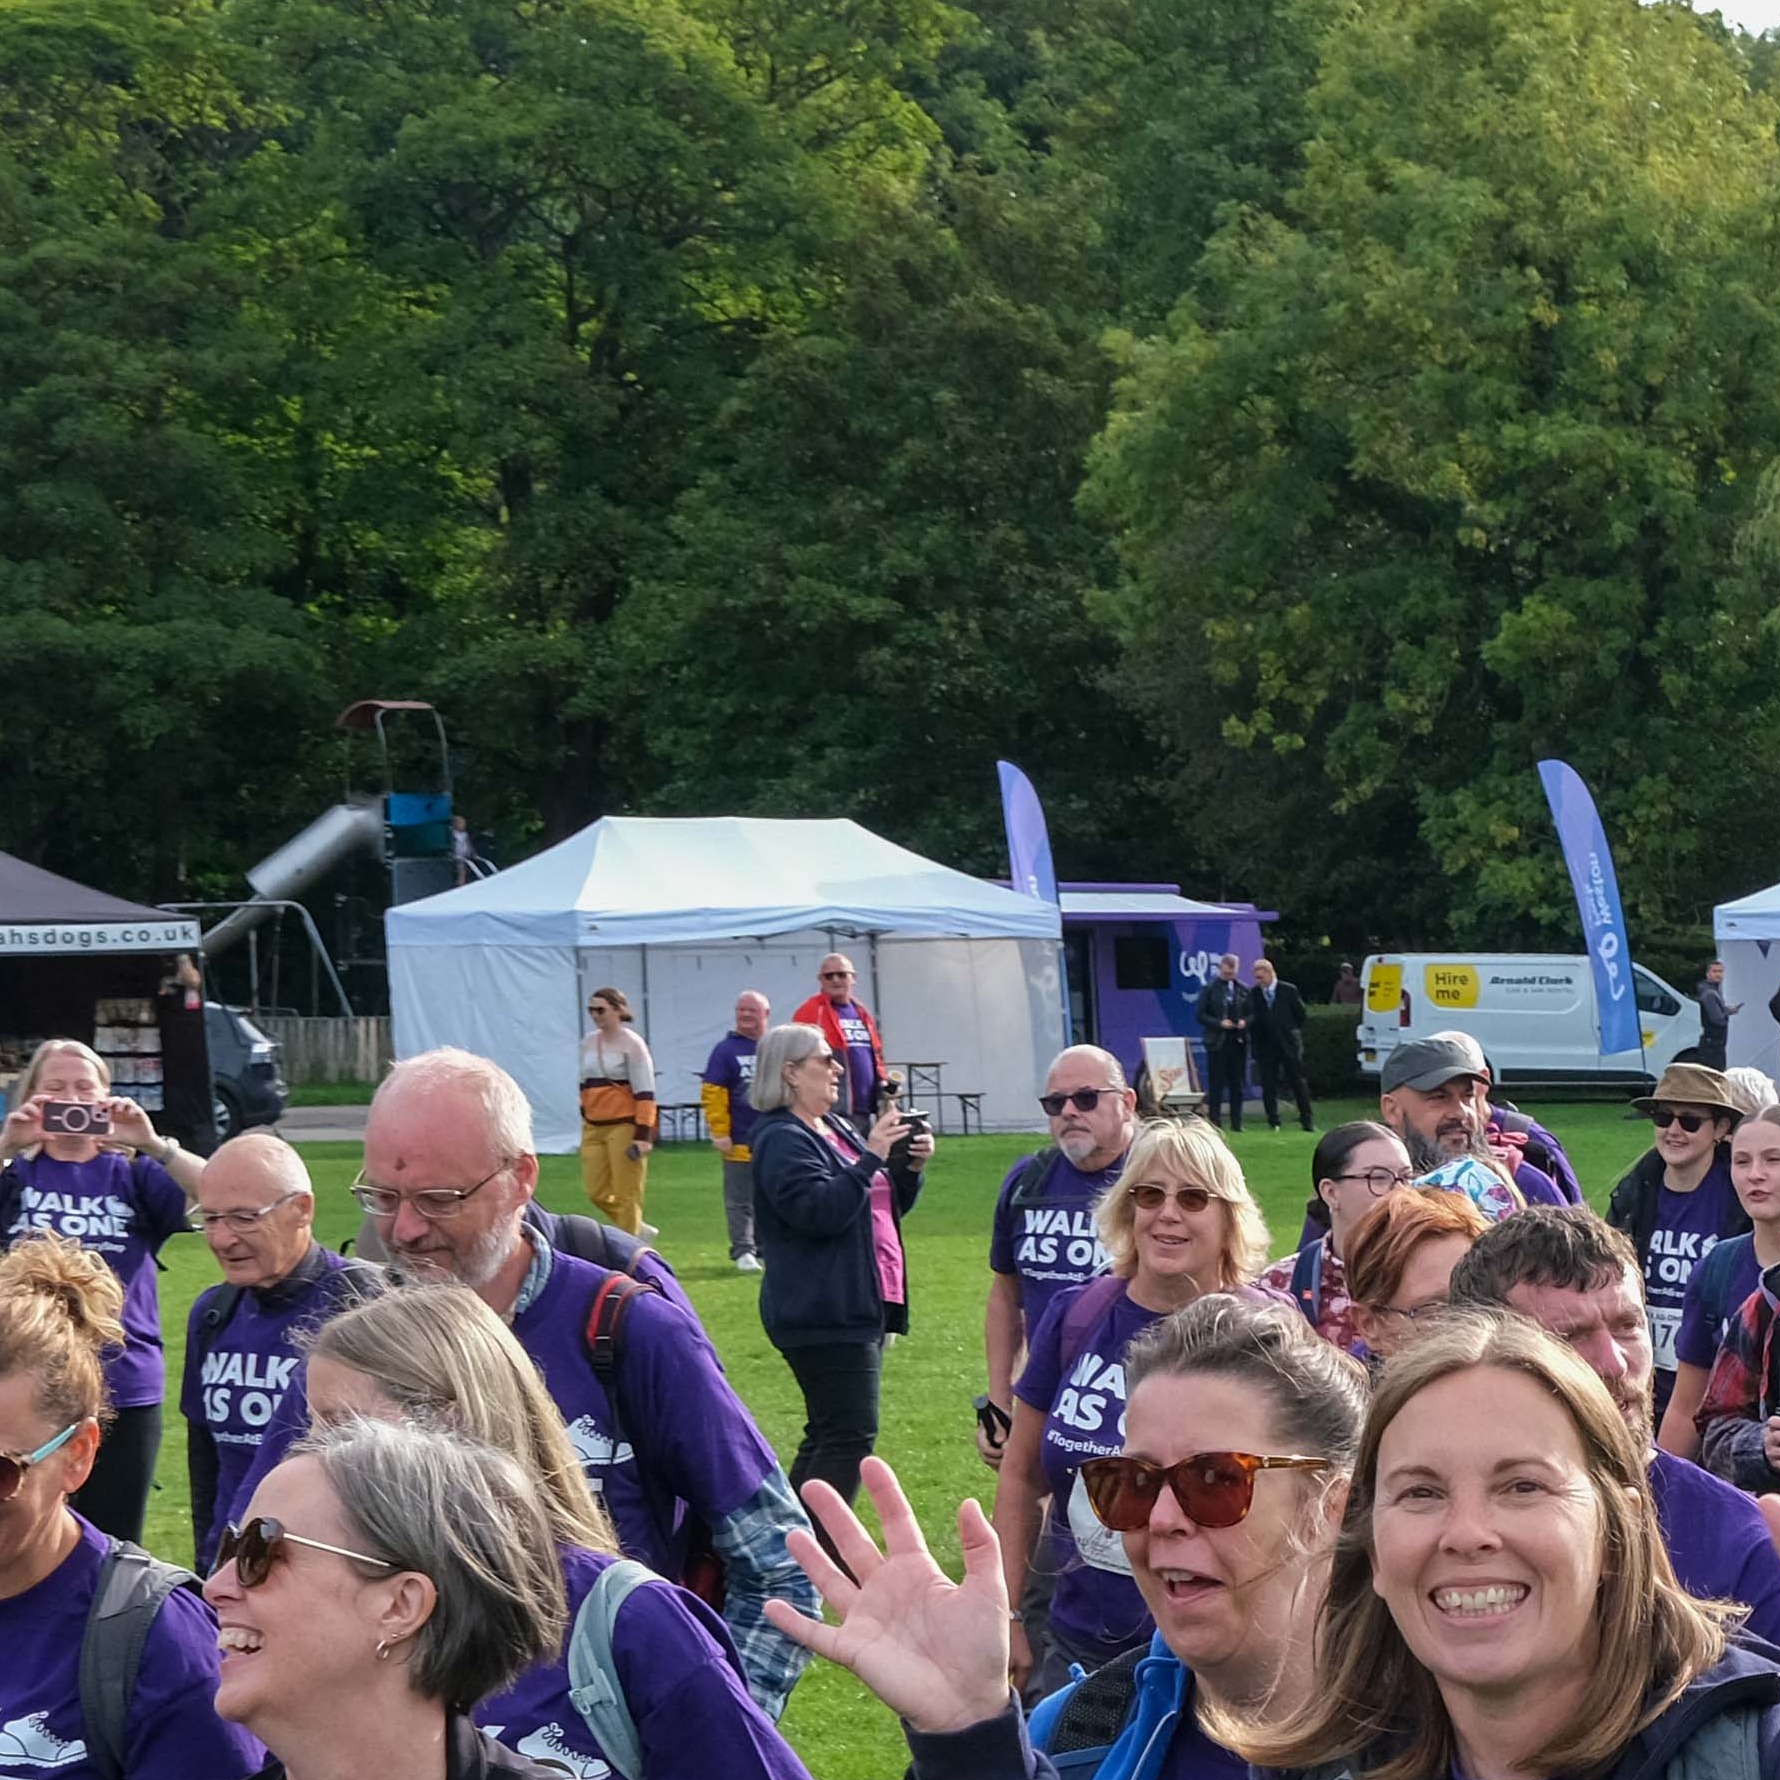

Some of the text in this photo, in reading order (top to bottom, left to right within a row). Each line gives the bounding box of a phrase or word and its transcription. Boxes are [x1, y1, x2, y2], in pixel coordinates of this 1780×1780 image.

[1434, 971, 1469, 986] Hire
[1435, 988, 1460, 1000] me
[59, 1212, 130, 1239] ONE
[1018, 1235, 1059, 1264] AS
[1649, 1229, 1701, 1259] ALK
[1051, 1386, 1108, 1432] AS
